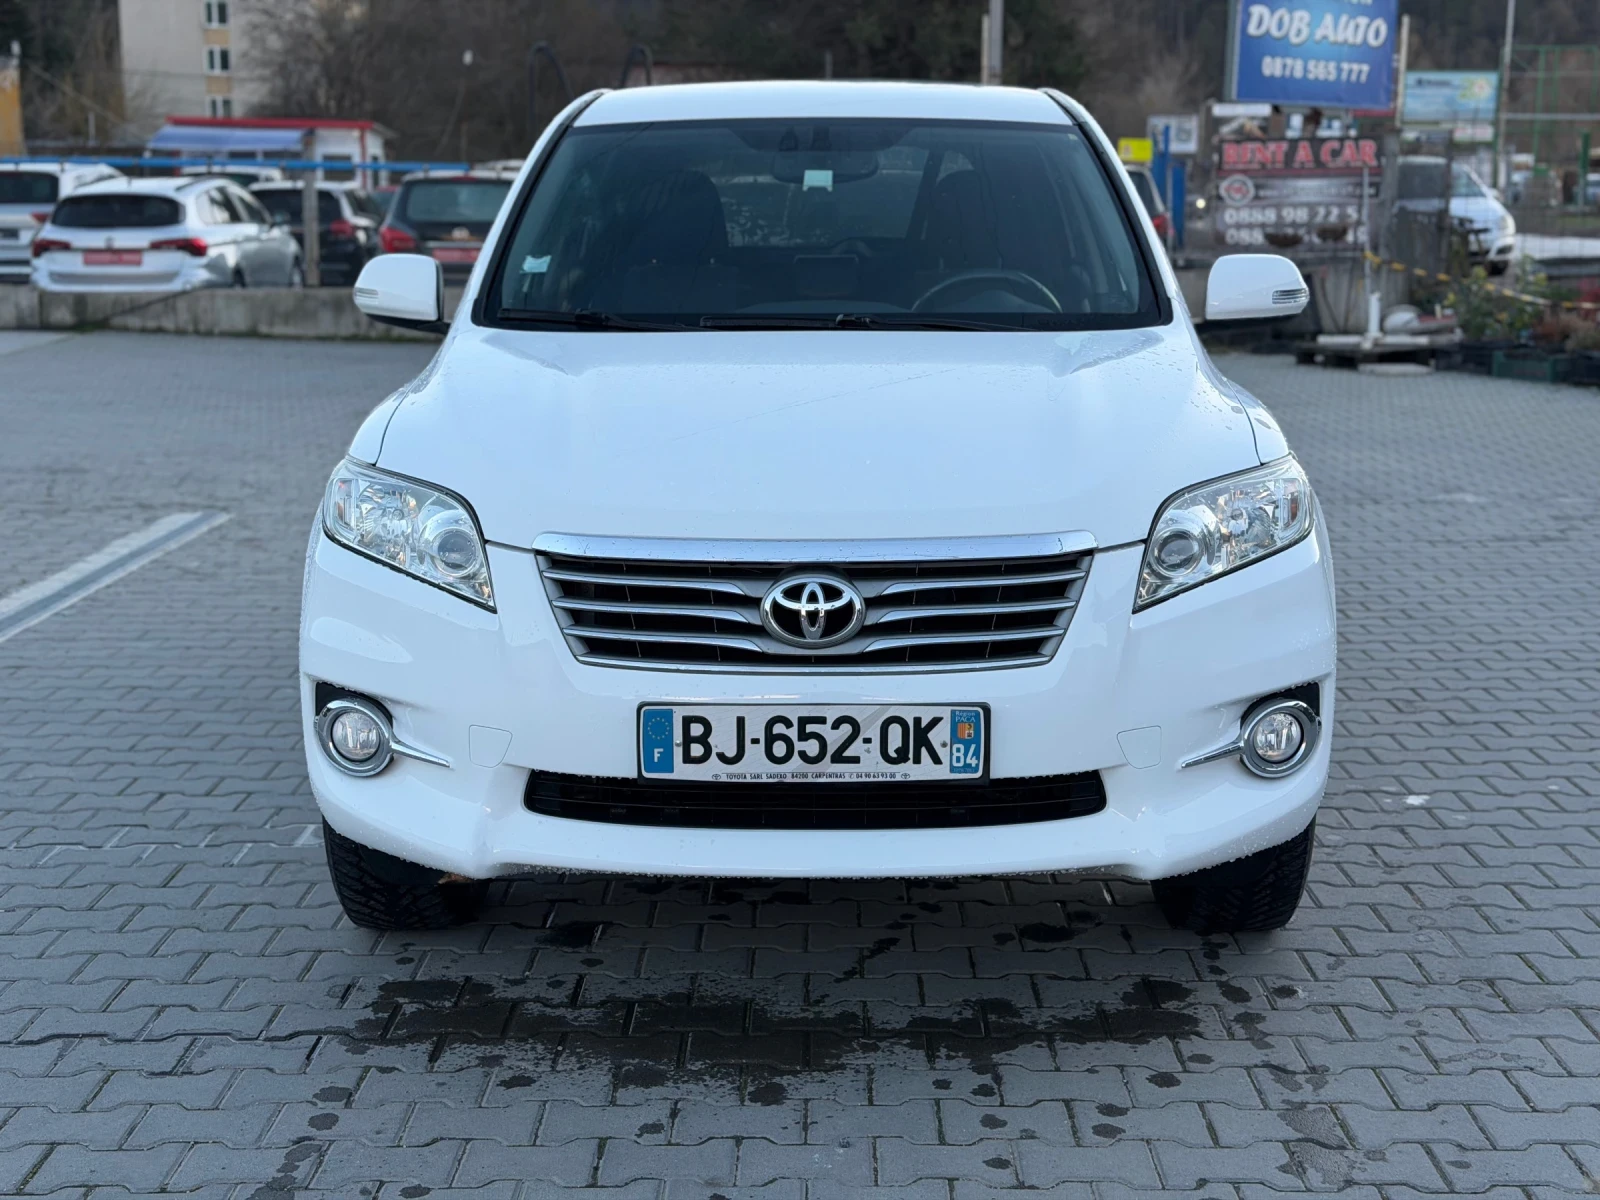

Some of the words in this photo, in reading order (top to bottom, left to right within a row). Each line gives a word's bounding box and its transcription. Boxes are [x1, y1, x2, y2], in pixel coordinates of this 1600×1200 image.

[1246, 4, 1311, 45] DOB
[1314, 12, 1388, 48] AUTO
[1340, 62, 1370, 84] 777
[1222, 139, 1289, 169] RENT
[1292, 140, 1315, 168] A
[1320, 138, 1378, 168] CAR
[682, 715, 943, 766] BJ-652-QK
[653, 748, 664, 763] F
[952, 744, 979, 767] 84
